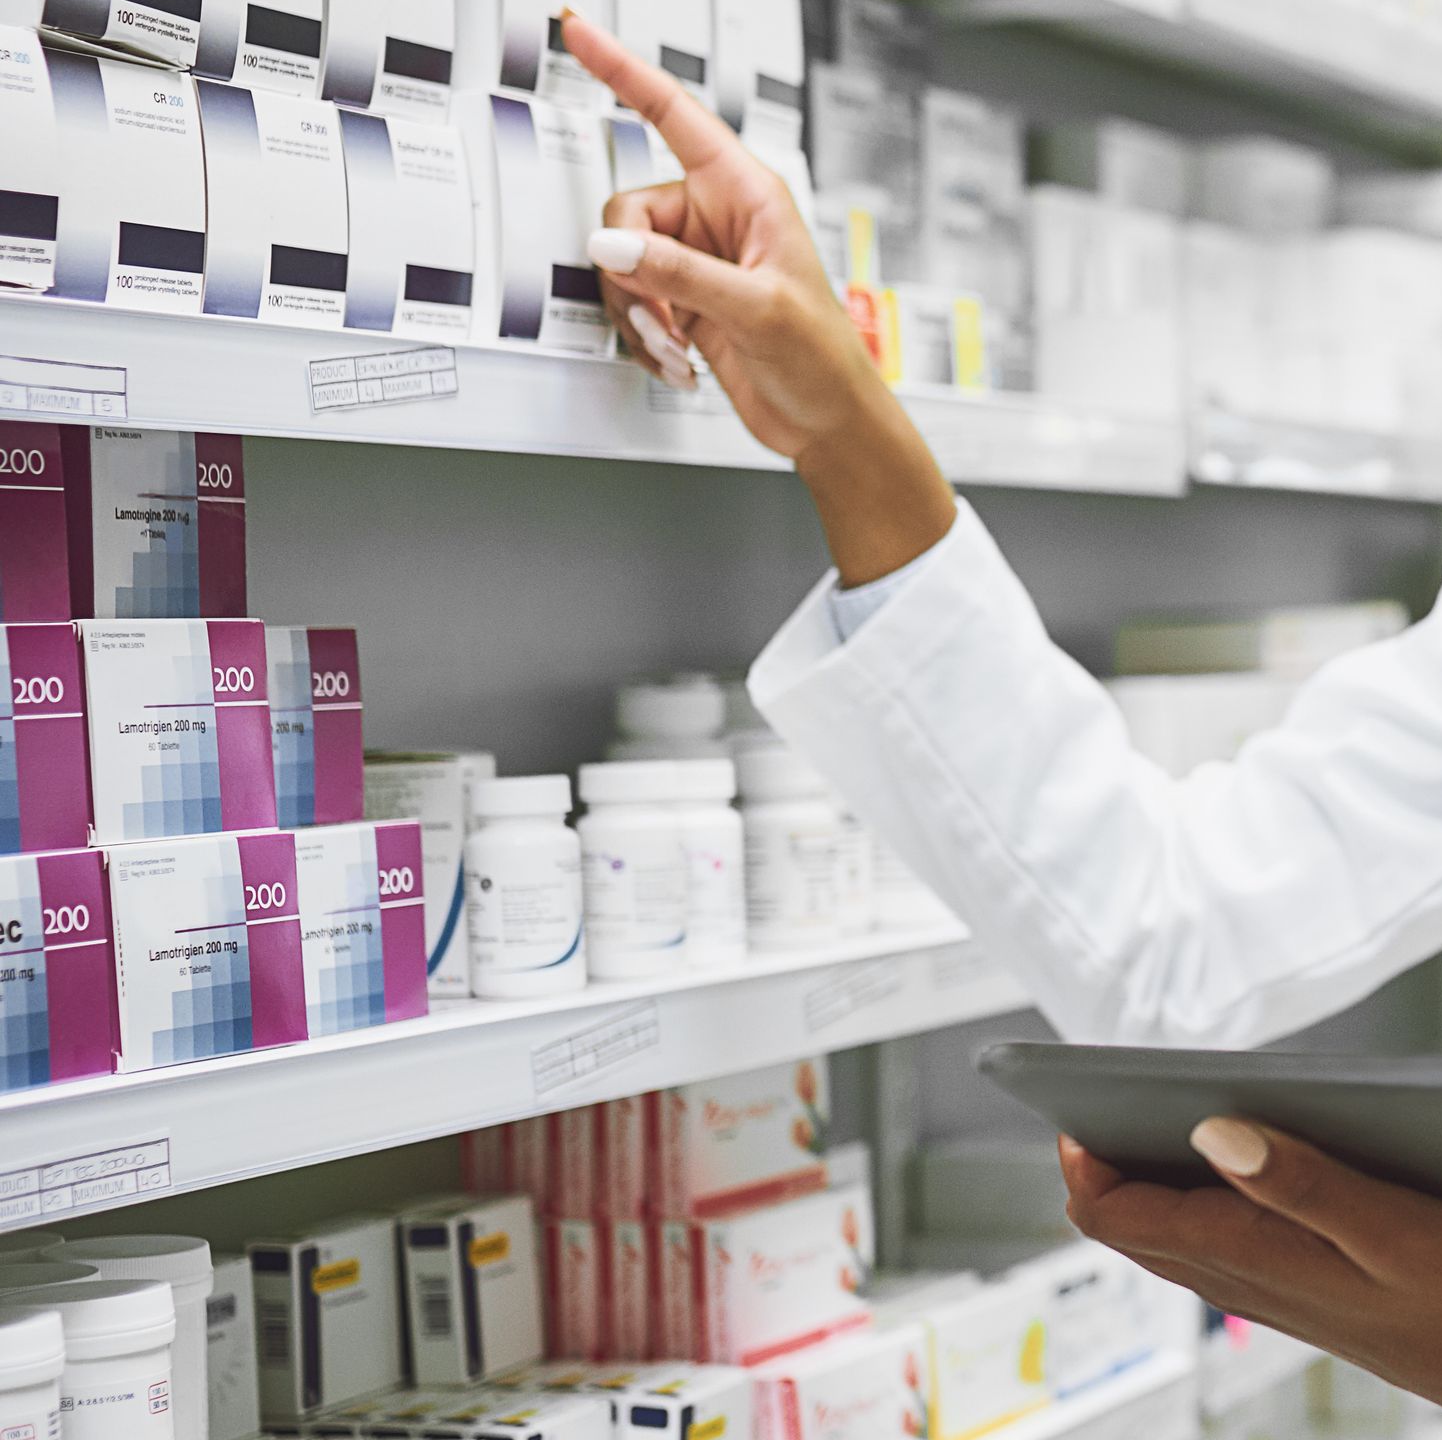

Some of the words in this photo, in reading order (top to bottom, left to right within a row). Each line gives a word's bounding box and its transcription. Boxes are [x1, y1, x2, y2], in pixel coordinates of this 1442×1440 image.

[117, 9, 134, 26] 100
[135, 11, 158, 25] prolonged
[243, 54, 258, 68] 100
[154, 92, 167, 105] CR
[168, 95, 183, 108] 200
[116, 275, 133, 289] 100
[134, 274, 159, 283] prolonged
[268, 294, 282, 308] 100
[312, 363, 350, 380] PRODUCT:
[314, 387, 353, 402] MINIMUM
[0, 449, 45, 475] 200
[199, 463, 232, 489] 200
[115, 507, 162, 524] Lamotrigine
[163, 509, 176, 522] 200
[214, 666, 254, 692] 200
[313, 671, 349, 697] 200
[13, 677, 64, 704] 200
[118, 720, 173, 737] Lamotrigien
[174, 720, 190, 732] 200
[192, 721, 206, 734] mg
[157, 741, 180, 751] Tablette
[379, 867, 414, 895] 200
[246, 882, 286, 910] 200
[44, 905, 89, 934] 200
[149, 943, 204, 962] Lamotrigien
[206, 941, 222, 955] 200
[223, 940, 238, 954] mg
[19, 968, 35, 981] mg
[188, 965, 212, 975] Tablette
[74, 1179, 125, 1201] MAXIMUM
